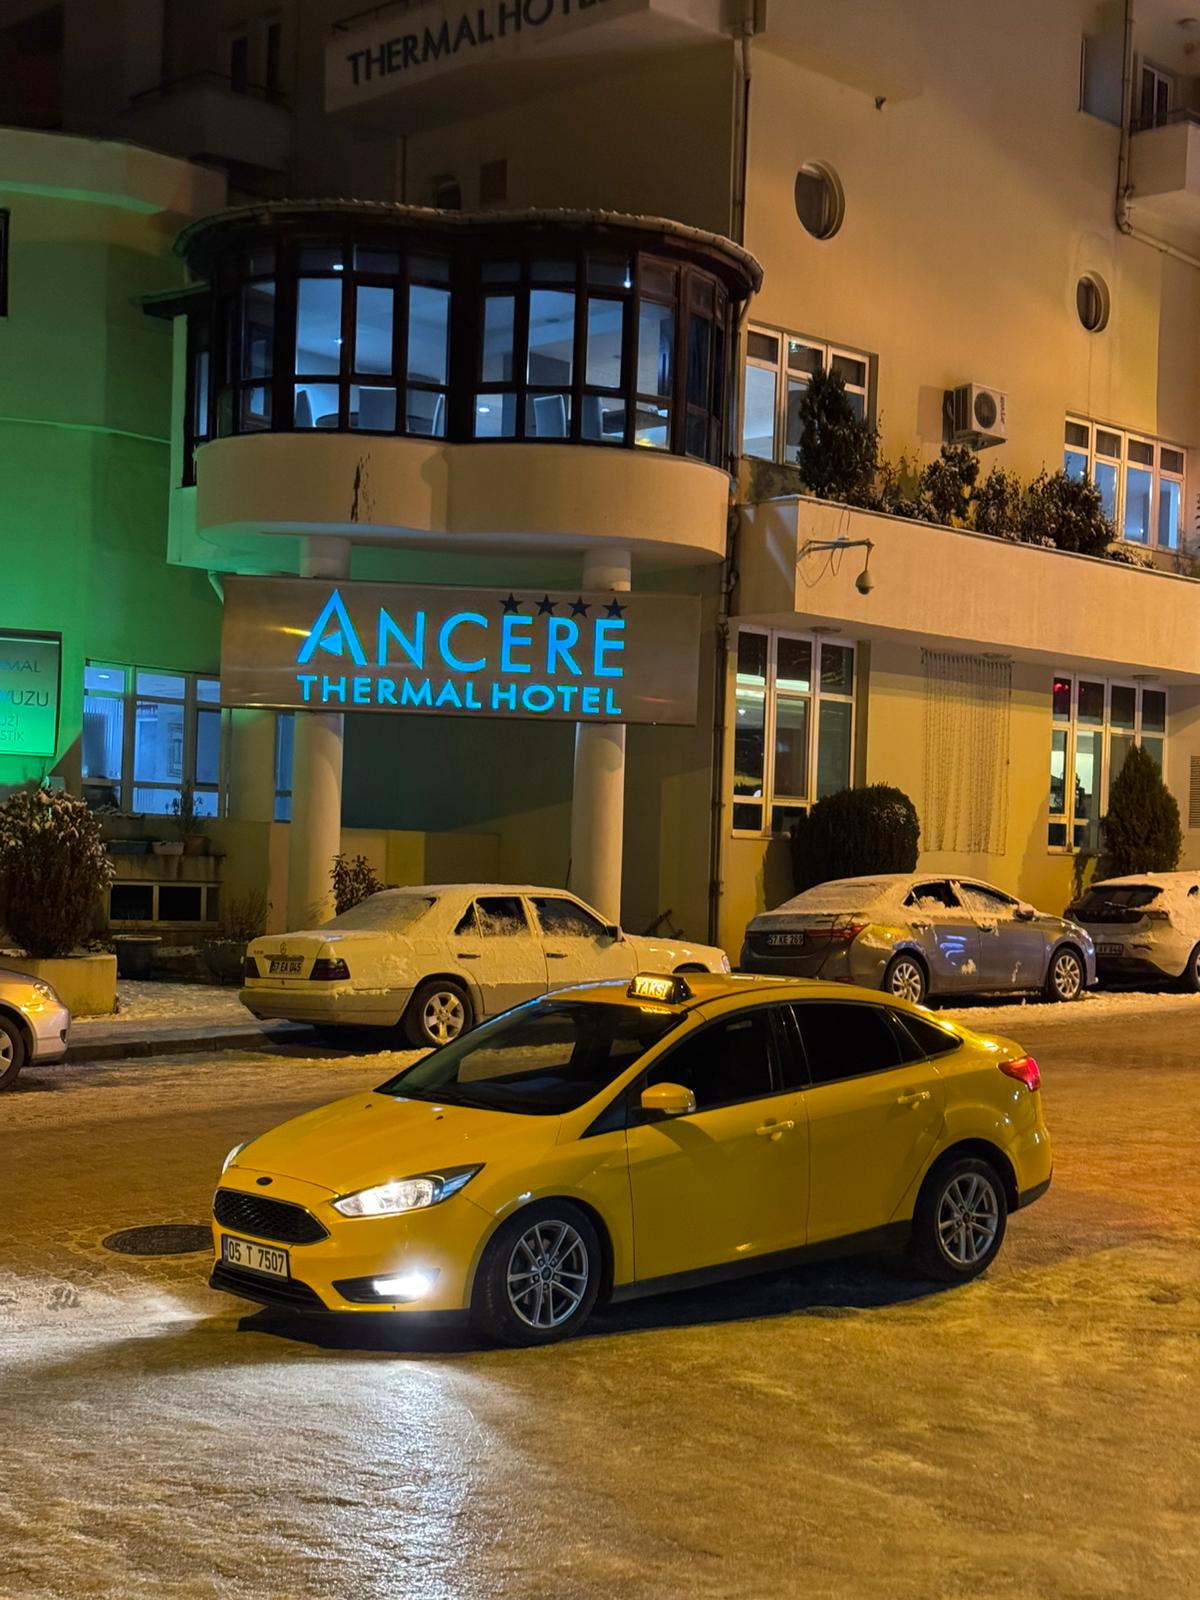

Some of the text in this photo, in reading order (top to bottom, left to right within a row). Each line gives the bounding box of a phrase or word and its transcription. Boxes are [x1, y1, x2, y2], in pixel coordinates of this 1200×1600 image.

[346, 9, 495, 85] THERMAL
[296, 588, 626, 677] ANCERE
[296, 675, 622, 715] THERMAL HOTEL
[229, 1241, 241, 1262] 05
[258, 1248, 285, 1273] 7507
